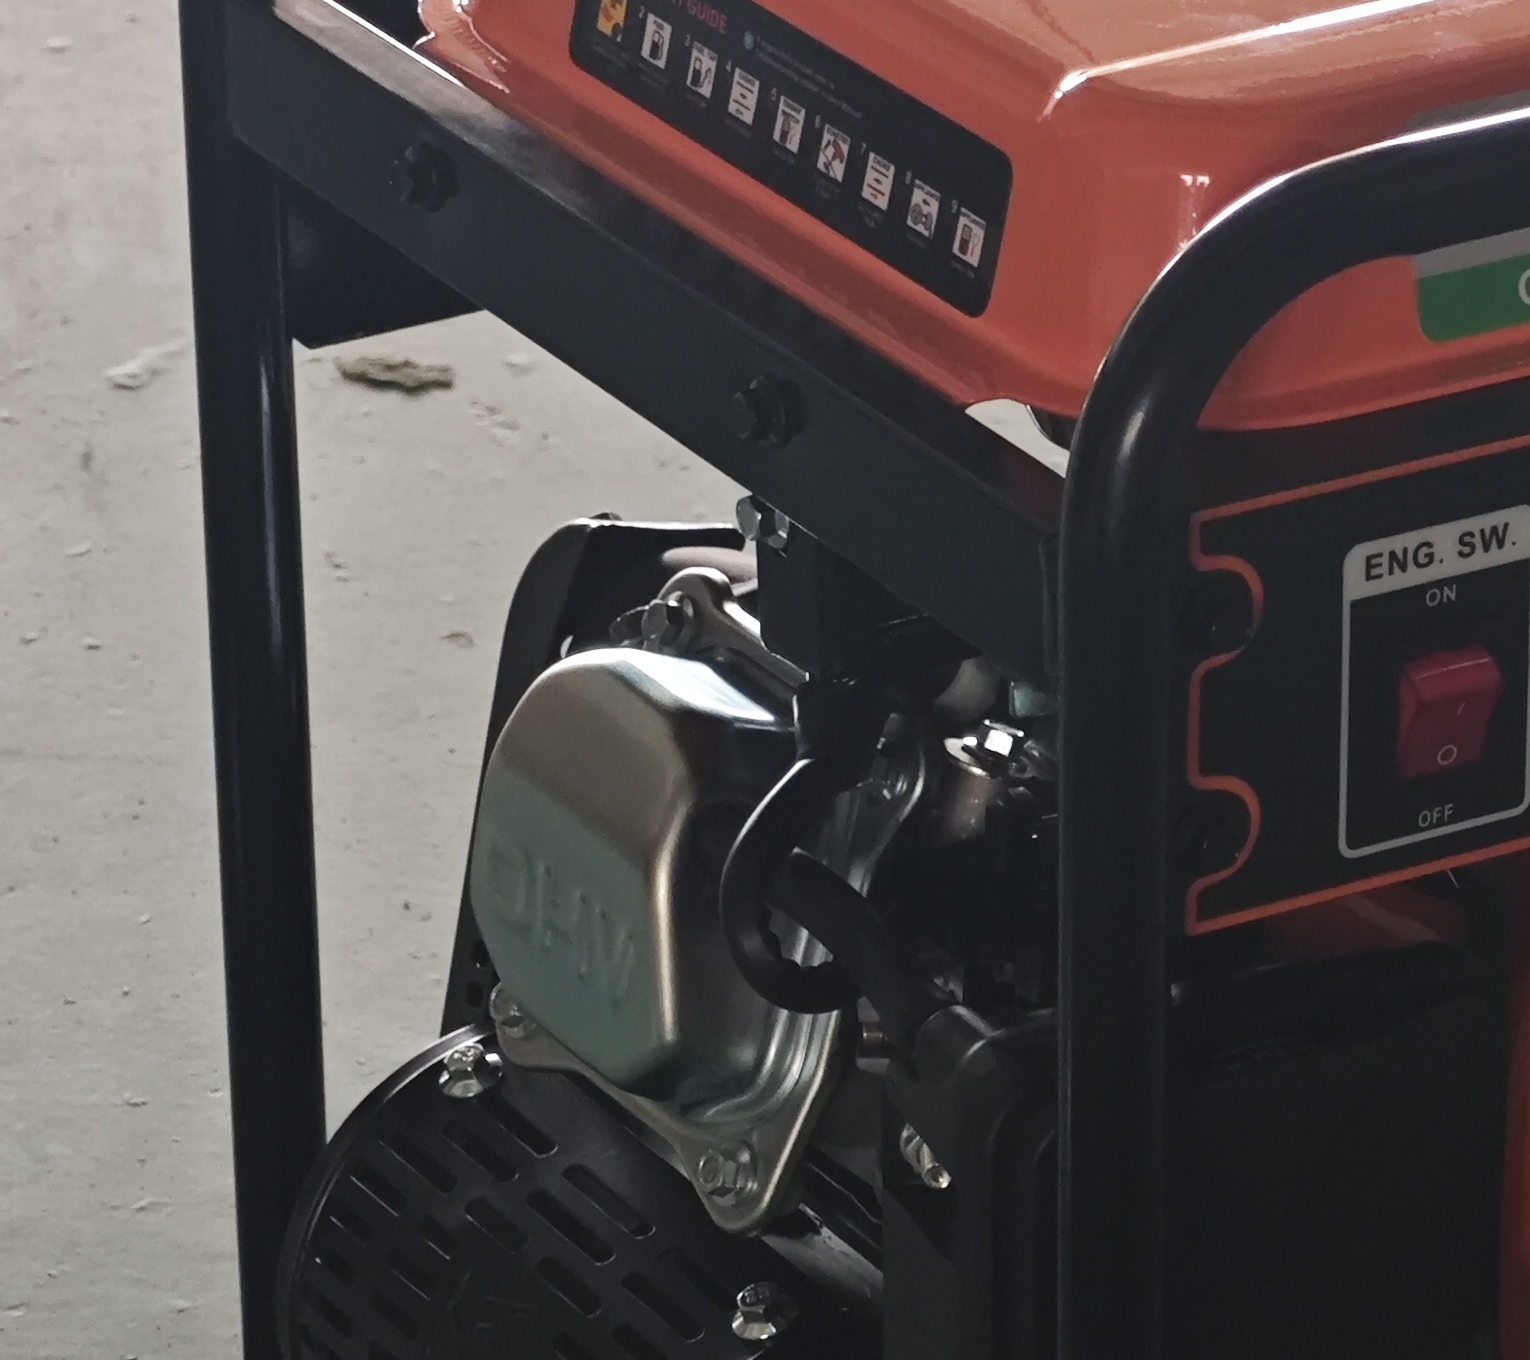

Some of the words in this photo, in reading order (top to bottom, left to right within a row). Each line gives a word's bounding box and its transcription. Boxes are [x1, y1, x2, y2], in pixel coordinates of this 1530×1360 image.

[1365, 541, 1444, 582] ENG.
[1457, 521, 1517, 559] SW.
[1425, 584, 1457, 607] ON
[1418, 803, 1454, 828] OFF
